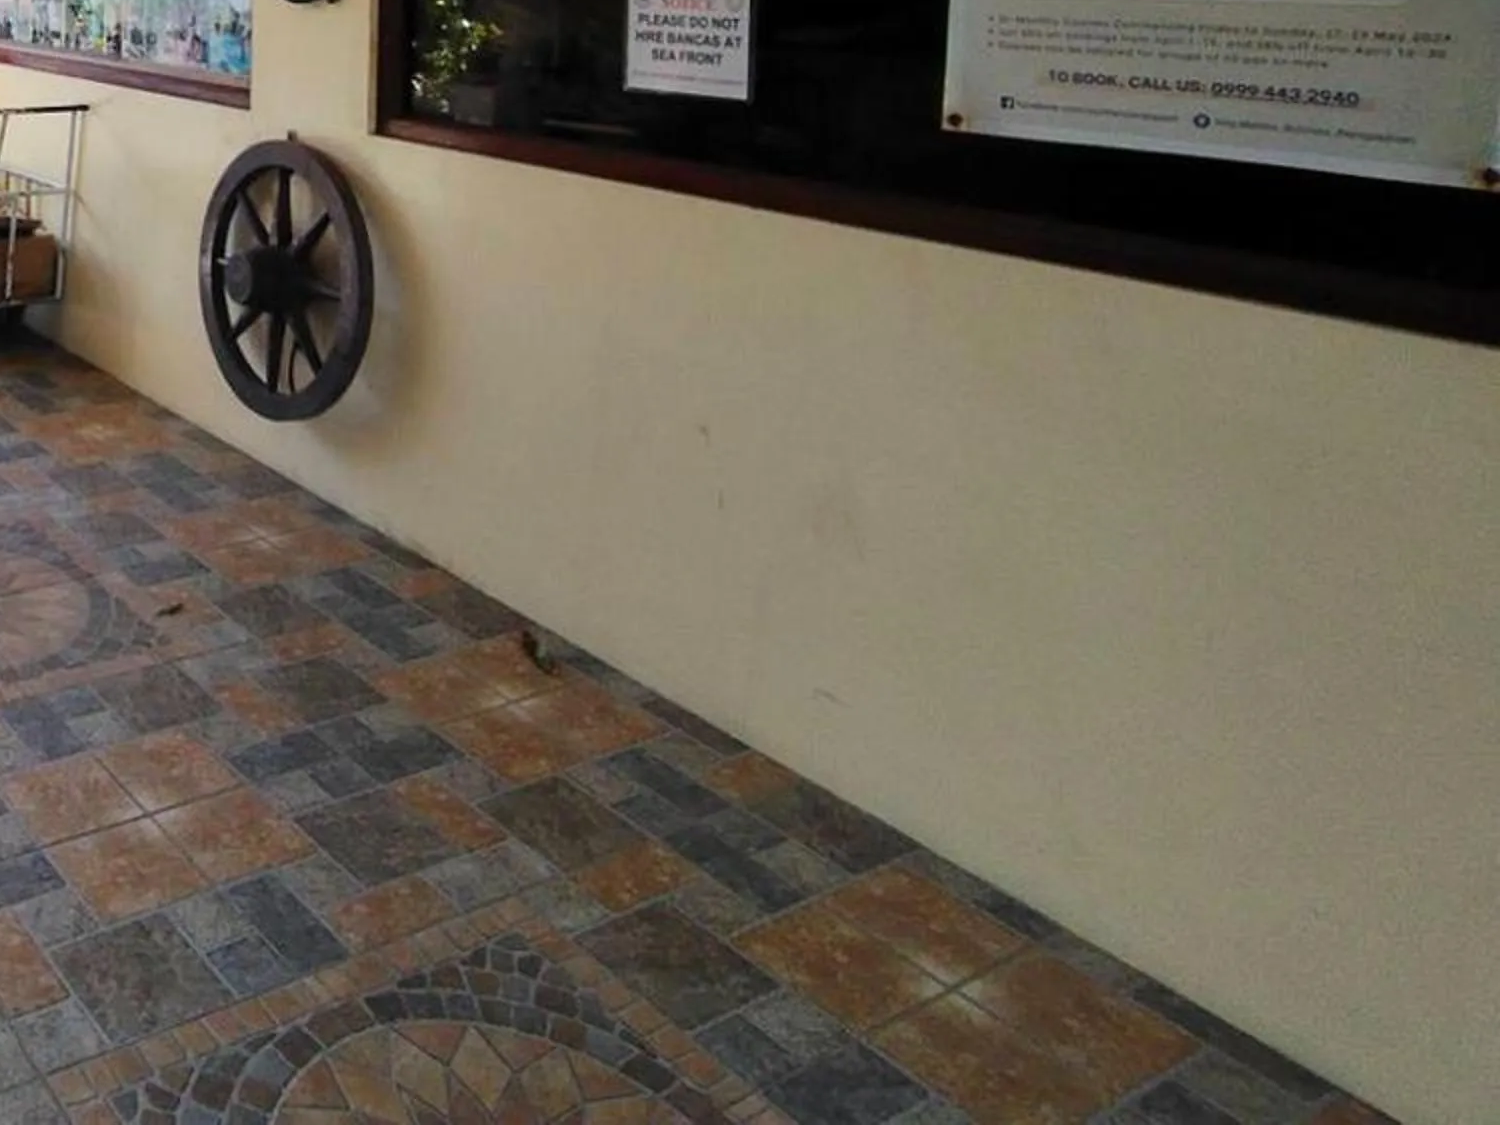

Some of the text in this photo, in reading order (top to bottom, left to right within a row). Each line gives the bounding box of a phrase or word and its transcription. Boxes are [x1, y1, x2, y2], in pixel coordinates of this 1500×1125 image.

[637, 12, 741, 31] PLEASE DO NOT
[667, 32, 721, 47] BANCAS
[724, 36, 743, 49] AT
[651, 48, 724, 67] SEA FRONT
[1048, 69, 1070, 83] TO
[1127, 75, 1173, 92] CALL
